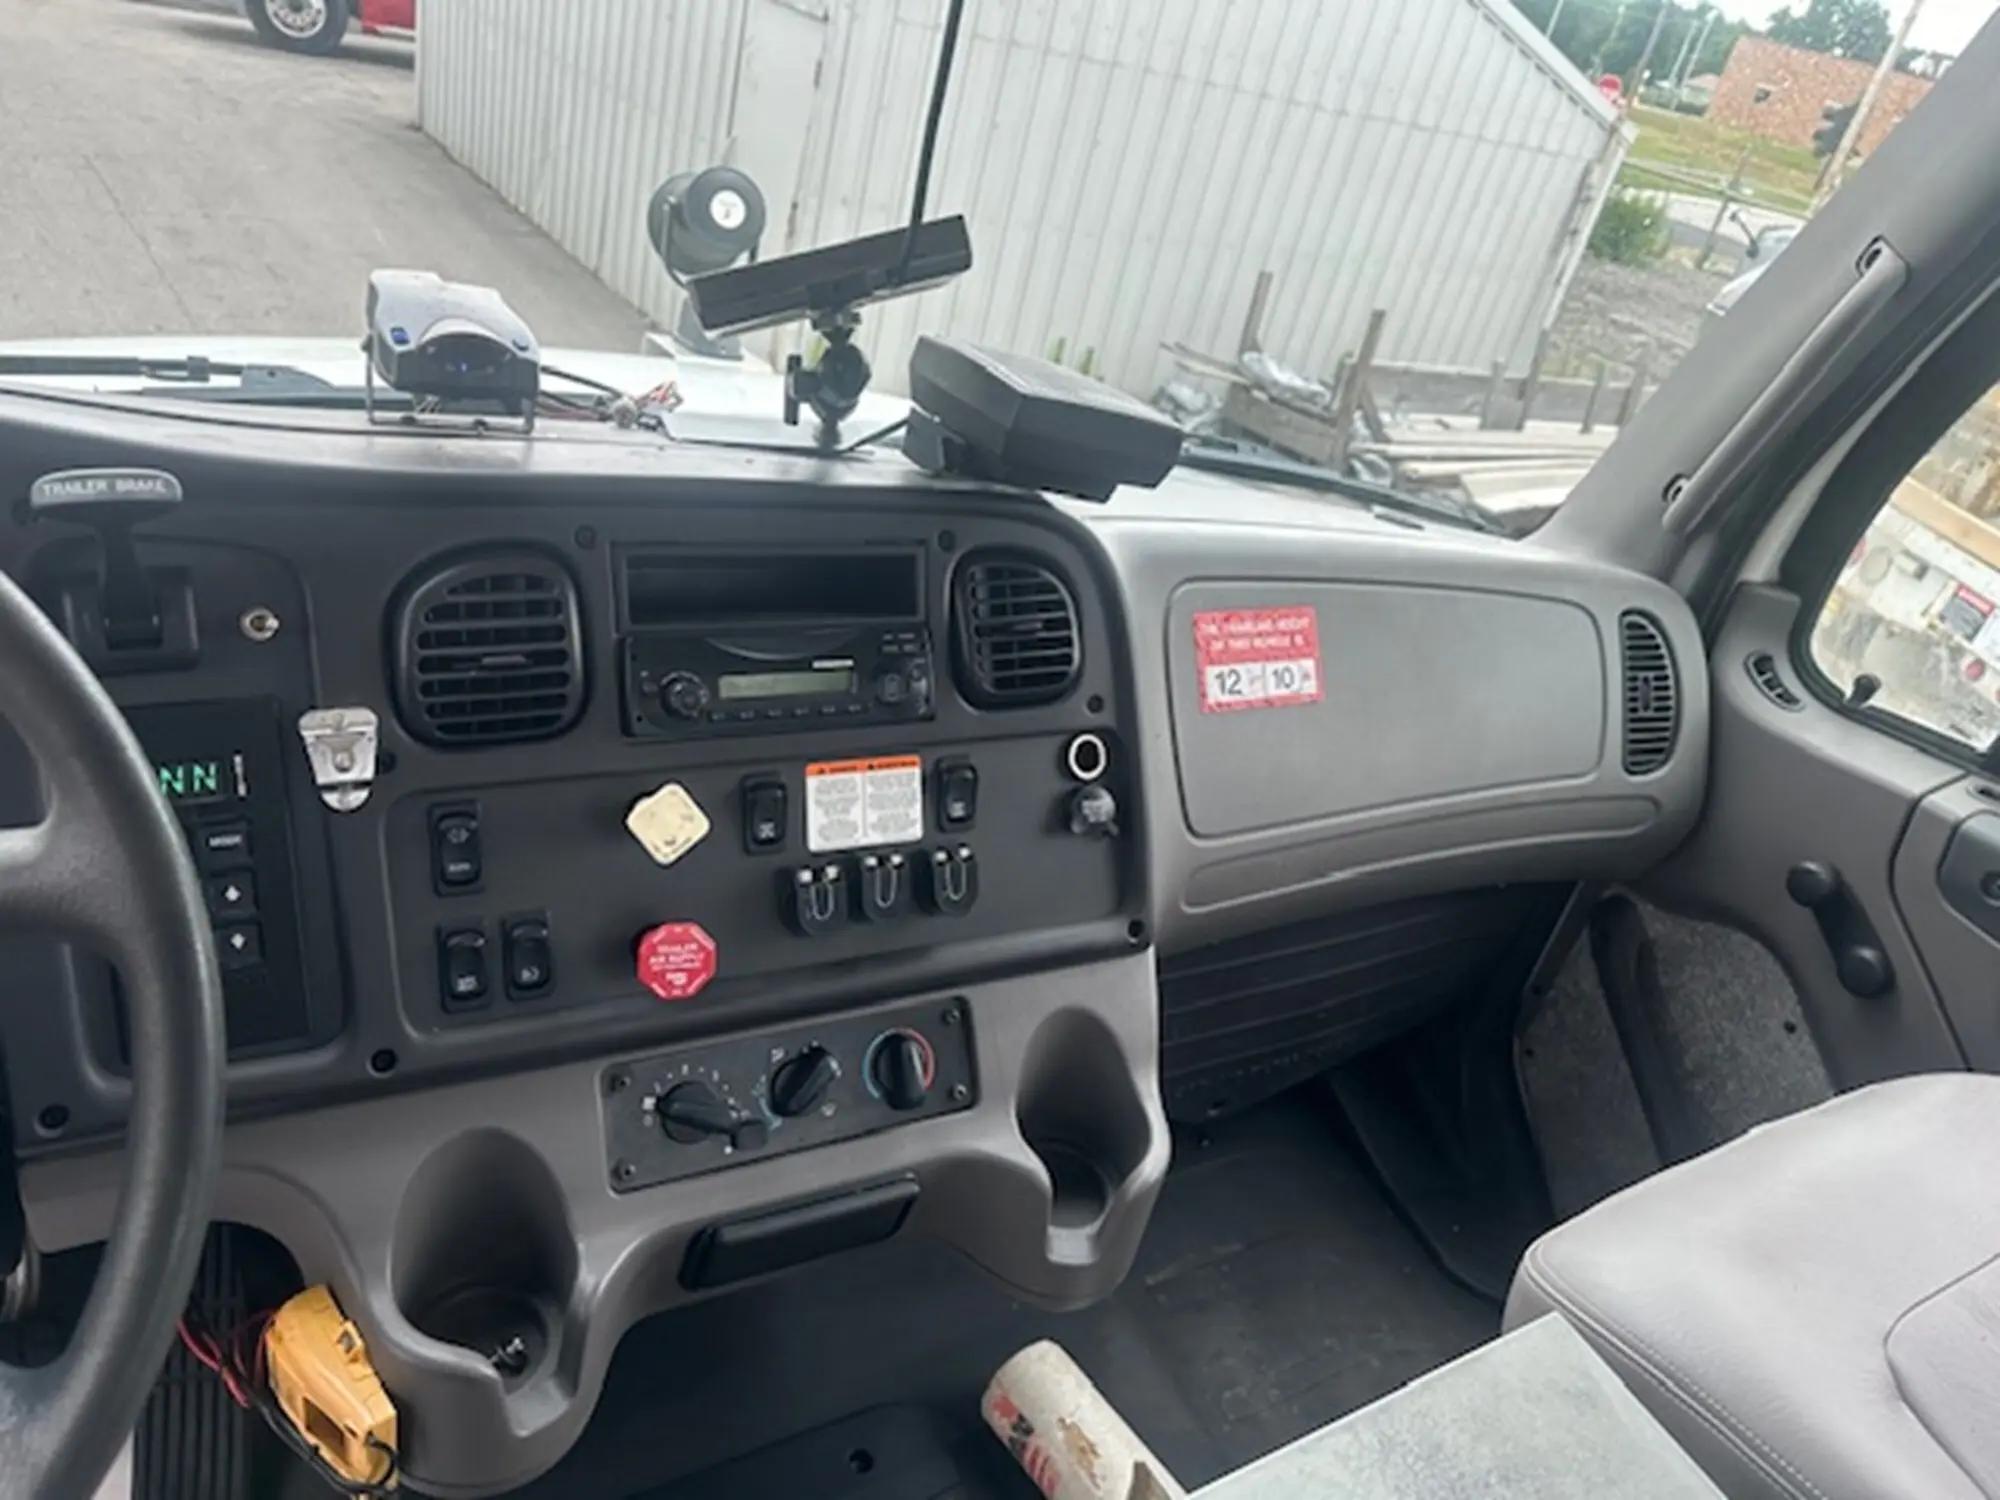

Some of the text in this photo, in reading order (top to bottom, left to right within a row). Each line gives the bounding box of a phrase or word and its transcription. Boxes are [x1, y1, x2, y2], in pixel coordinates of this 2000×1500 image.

[42, 478, 167, 497] TRAILER BRAKE
[1214, 668, 1244, 696] 12
[1271, 666, 1295, 690] 10
